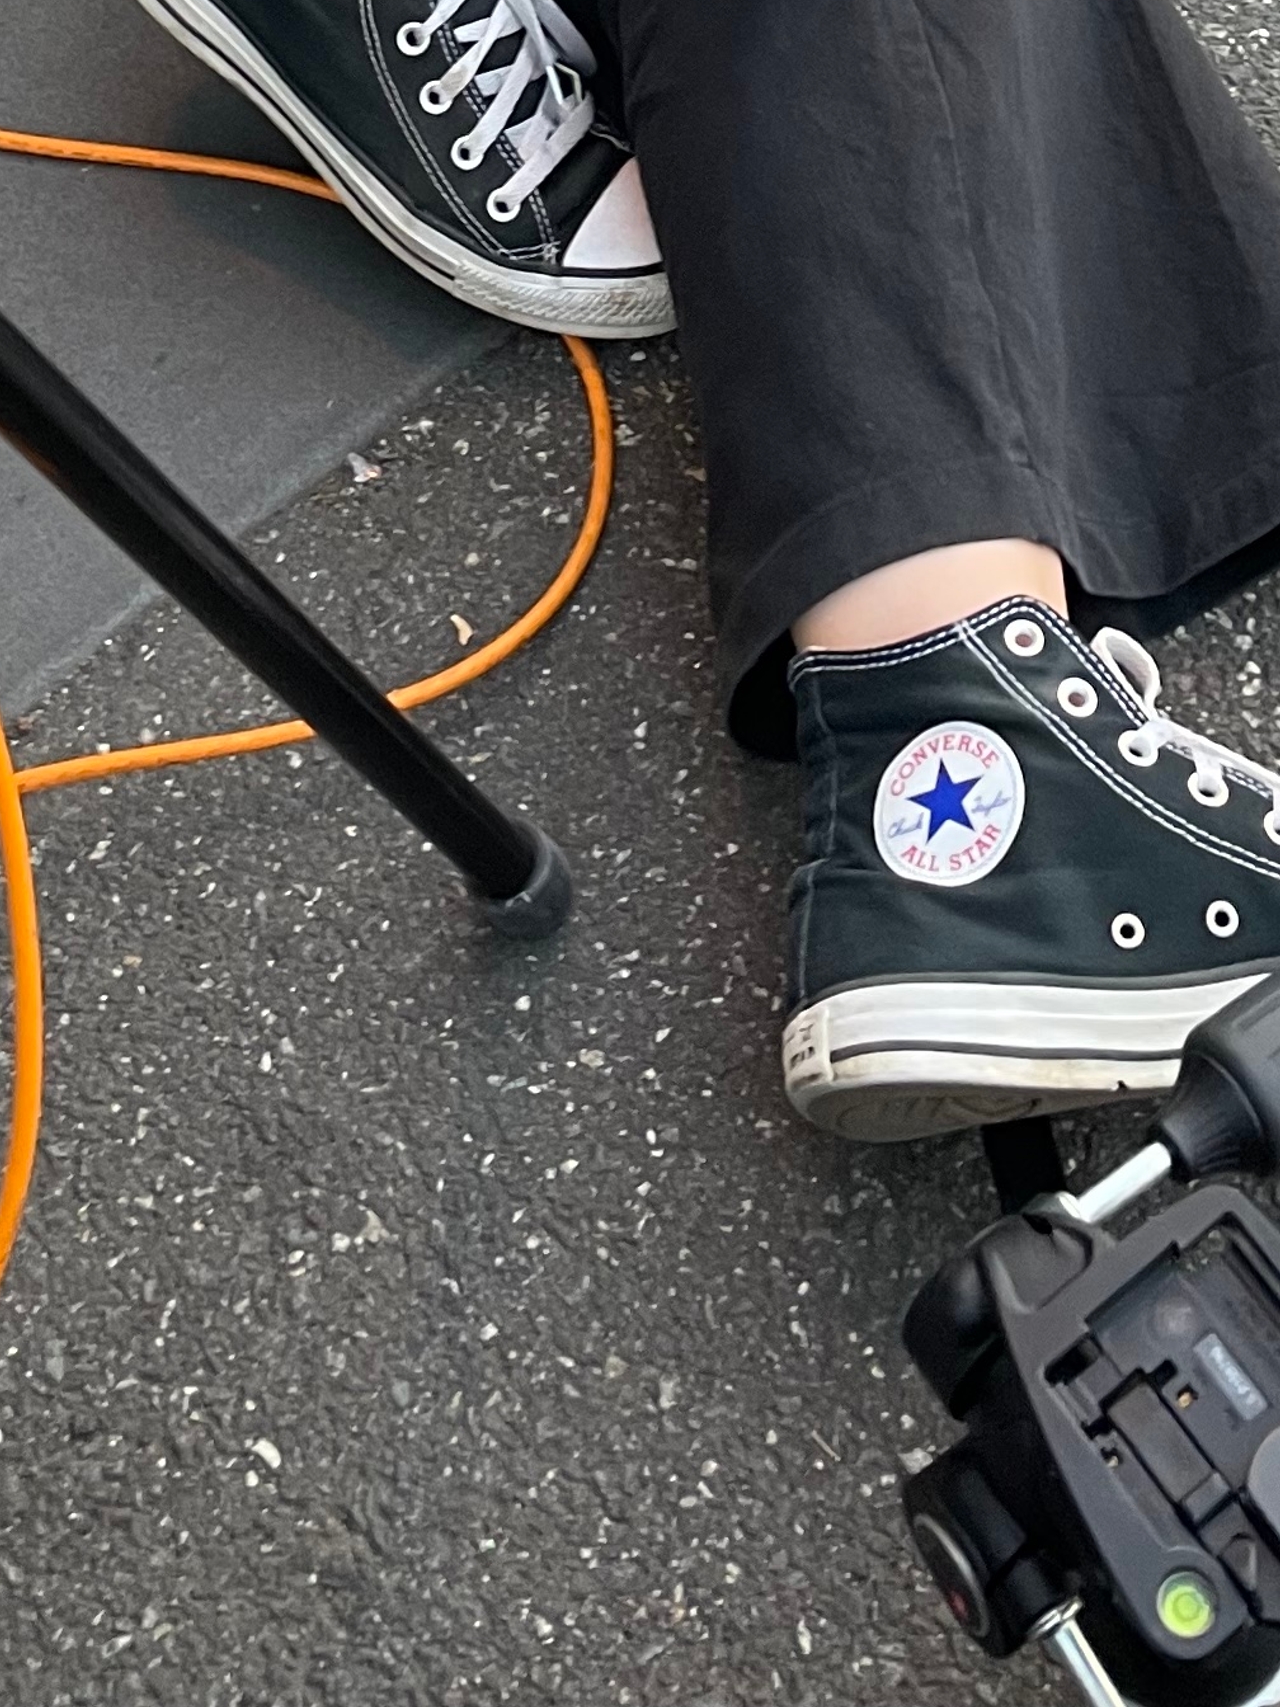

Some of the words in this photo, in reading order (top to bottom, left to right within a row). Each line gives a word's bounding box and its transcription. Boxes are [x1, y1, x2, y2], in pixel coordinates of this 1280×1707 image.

[890, 734, 1000, 798] CONVERSE
[900, 844, 941, 873] ALL
[948, 823, 1002, 872] STAR
